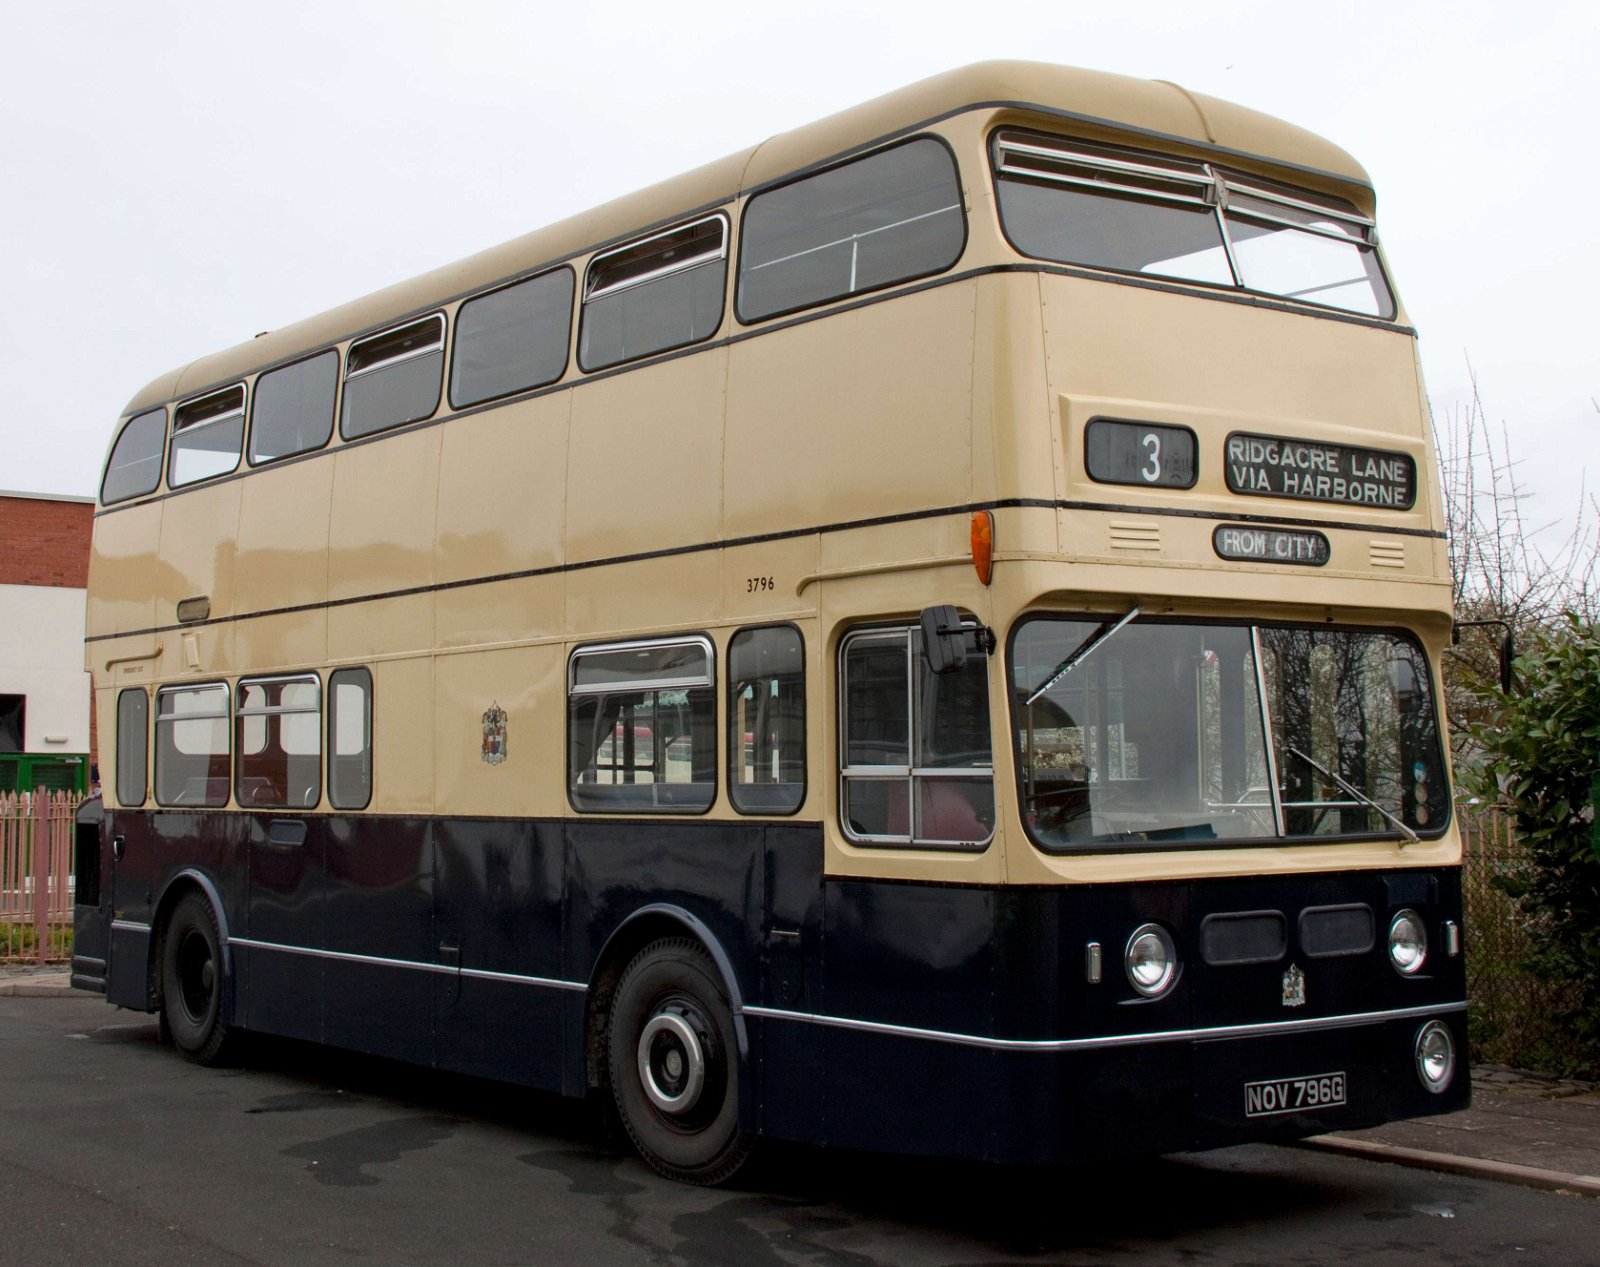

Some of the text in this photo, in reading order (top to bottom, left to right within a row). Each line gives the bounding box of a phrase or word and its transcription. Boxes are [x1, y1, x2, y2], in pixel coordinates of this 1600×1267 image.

[1142, 433, 1160, 482] 3
[1229, 437, 1406, 483] RIDGACRE LANE
[1232, 465, 1406, 505] VIA HARBORNE
[1223, 530, 1314, 559] FROM CITY
[747, 576, 774, 593] 3796
[1248, 1076, 1344, 1112] NOV 796G
